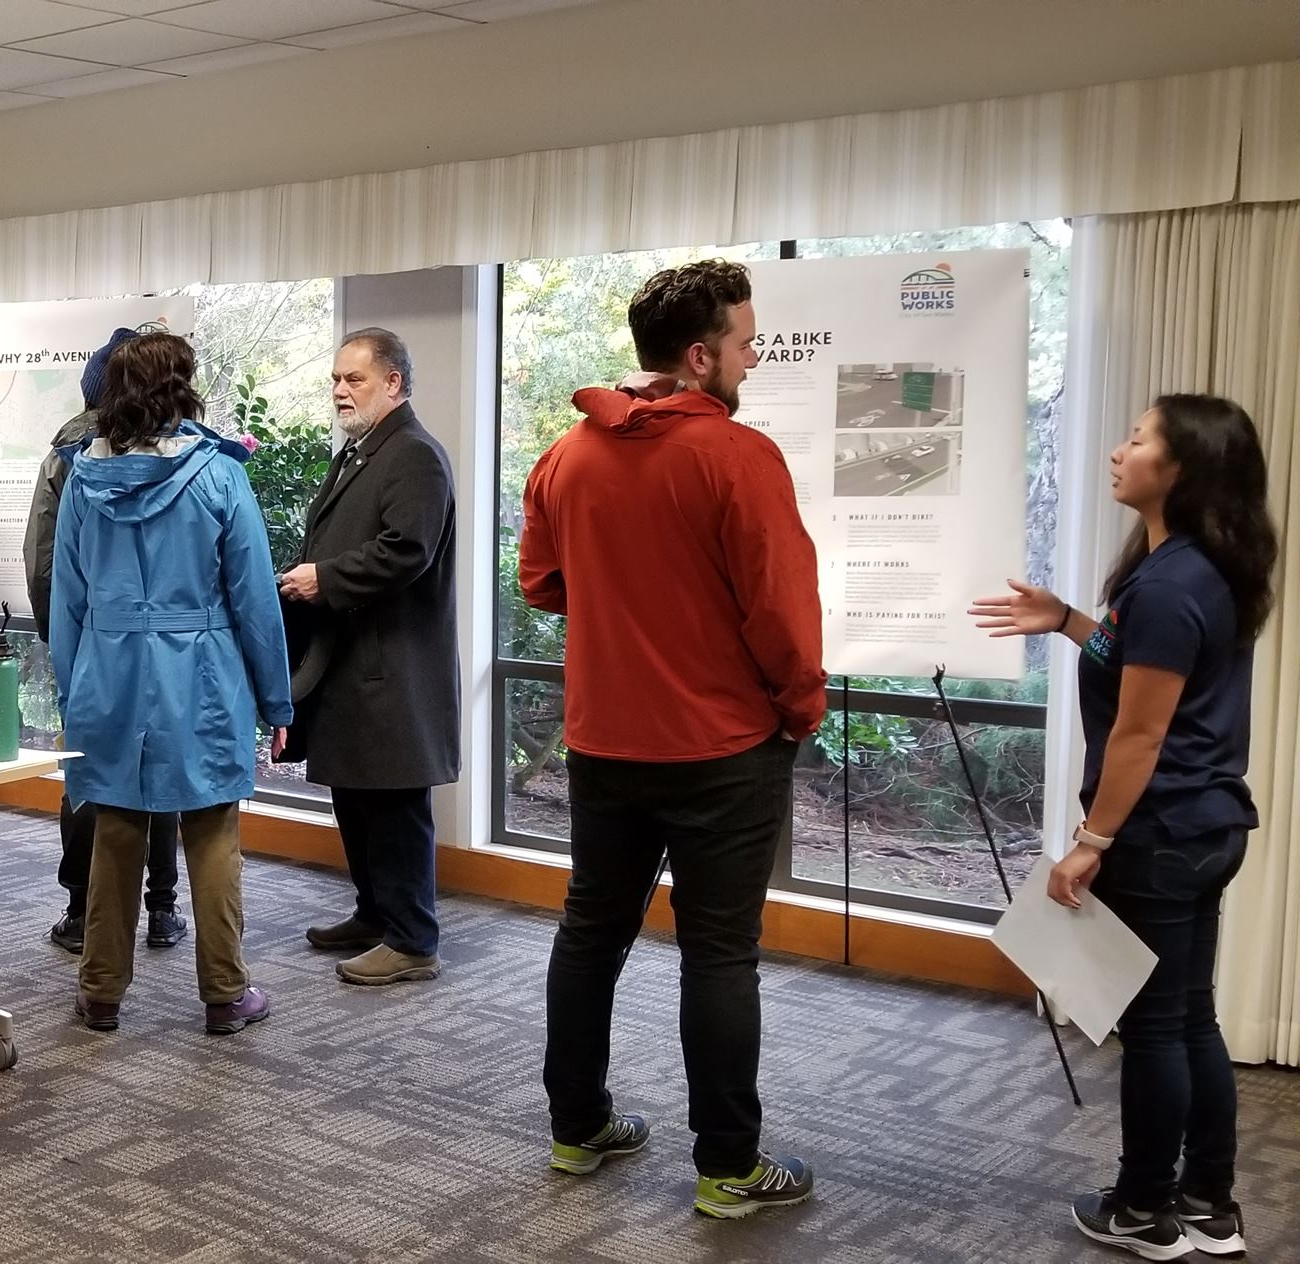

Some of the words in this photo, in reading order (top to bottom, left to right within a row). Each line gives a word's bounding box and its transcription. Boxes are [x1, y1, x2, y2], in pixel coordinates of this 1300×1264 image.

[900, 290, 954, 300] PUBLIC
[900, 300, 955, 310] WORKS
[755, 333, 766, 346] S
[772, 333, 785, 346] A
[792, 332, 832, 346] BIKE
[26, 348, 50, 363] 28th
[757, 349, 815, 362] VARD?
